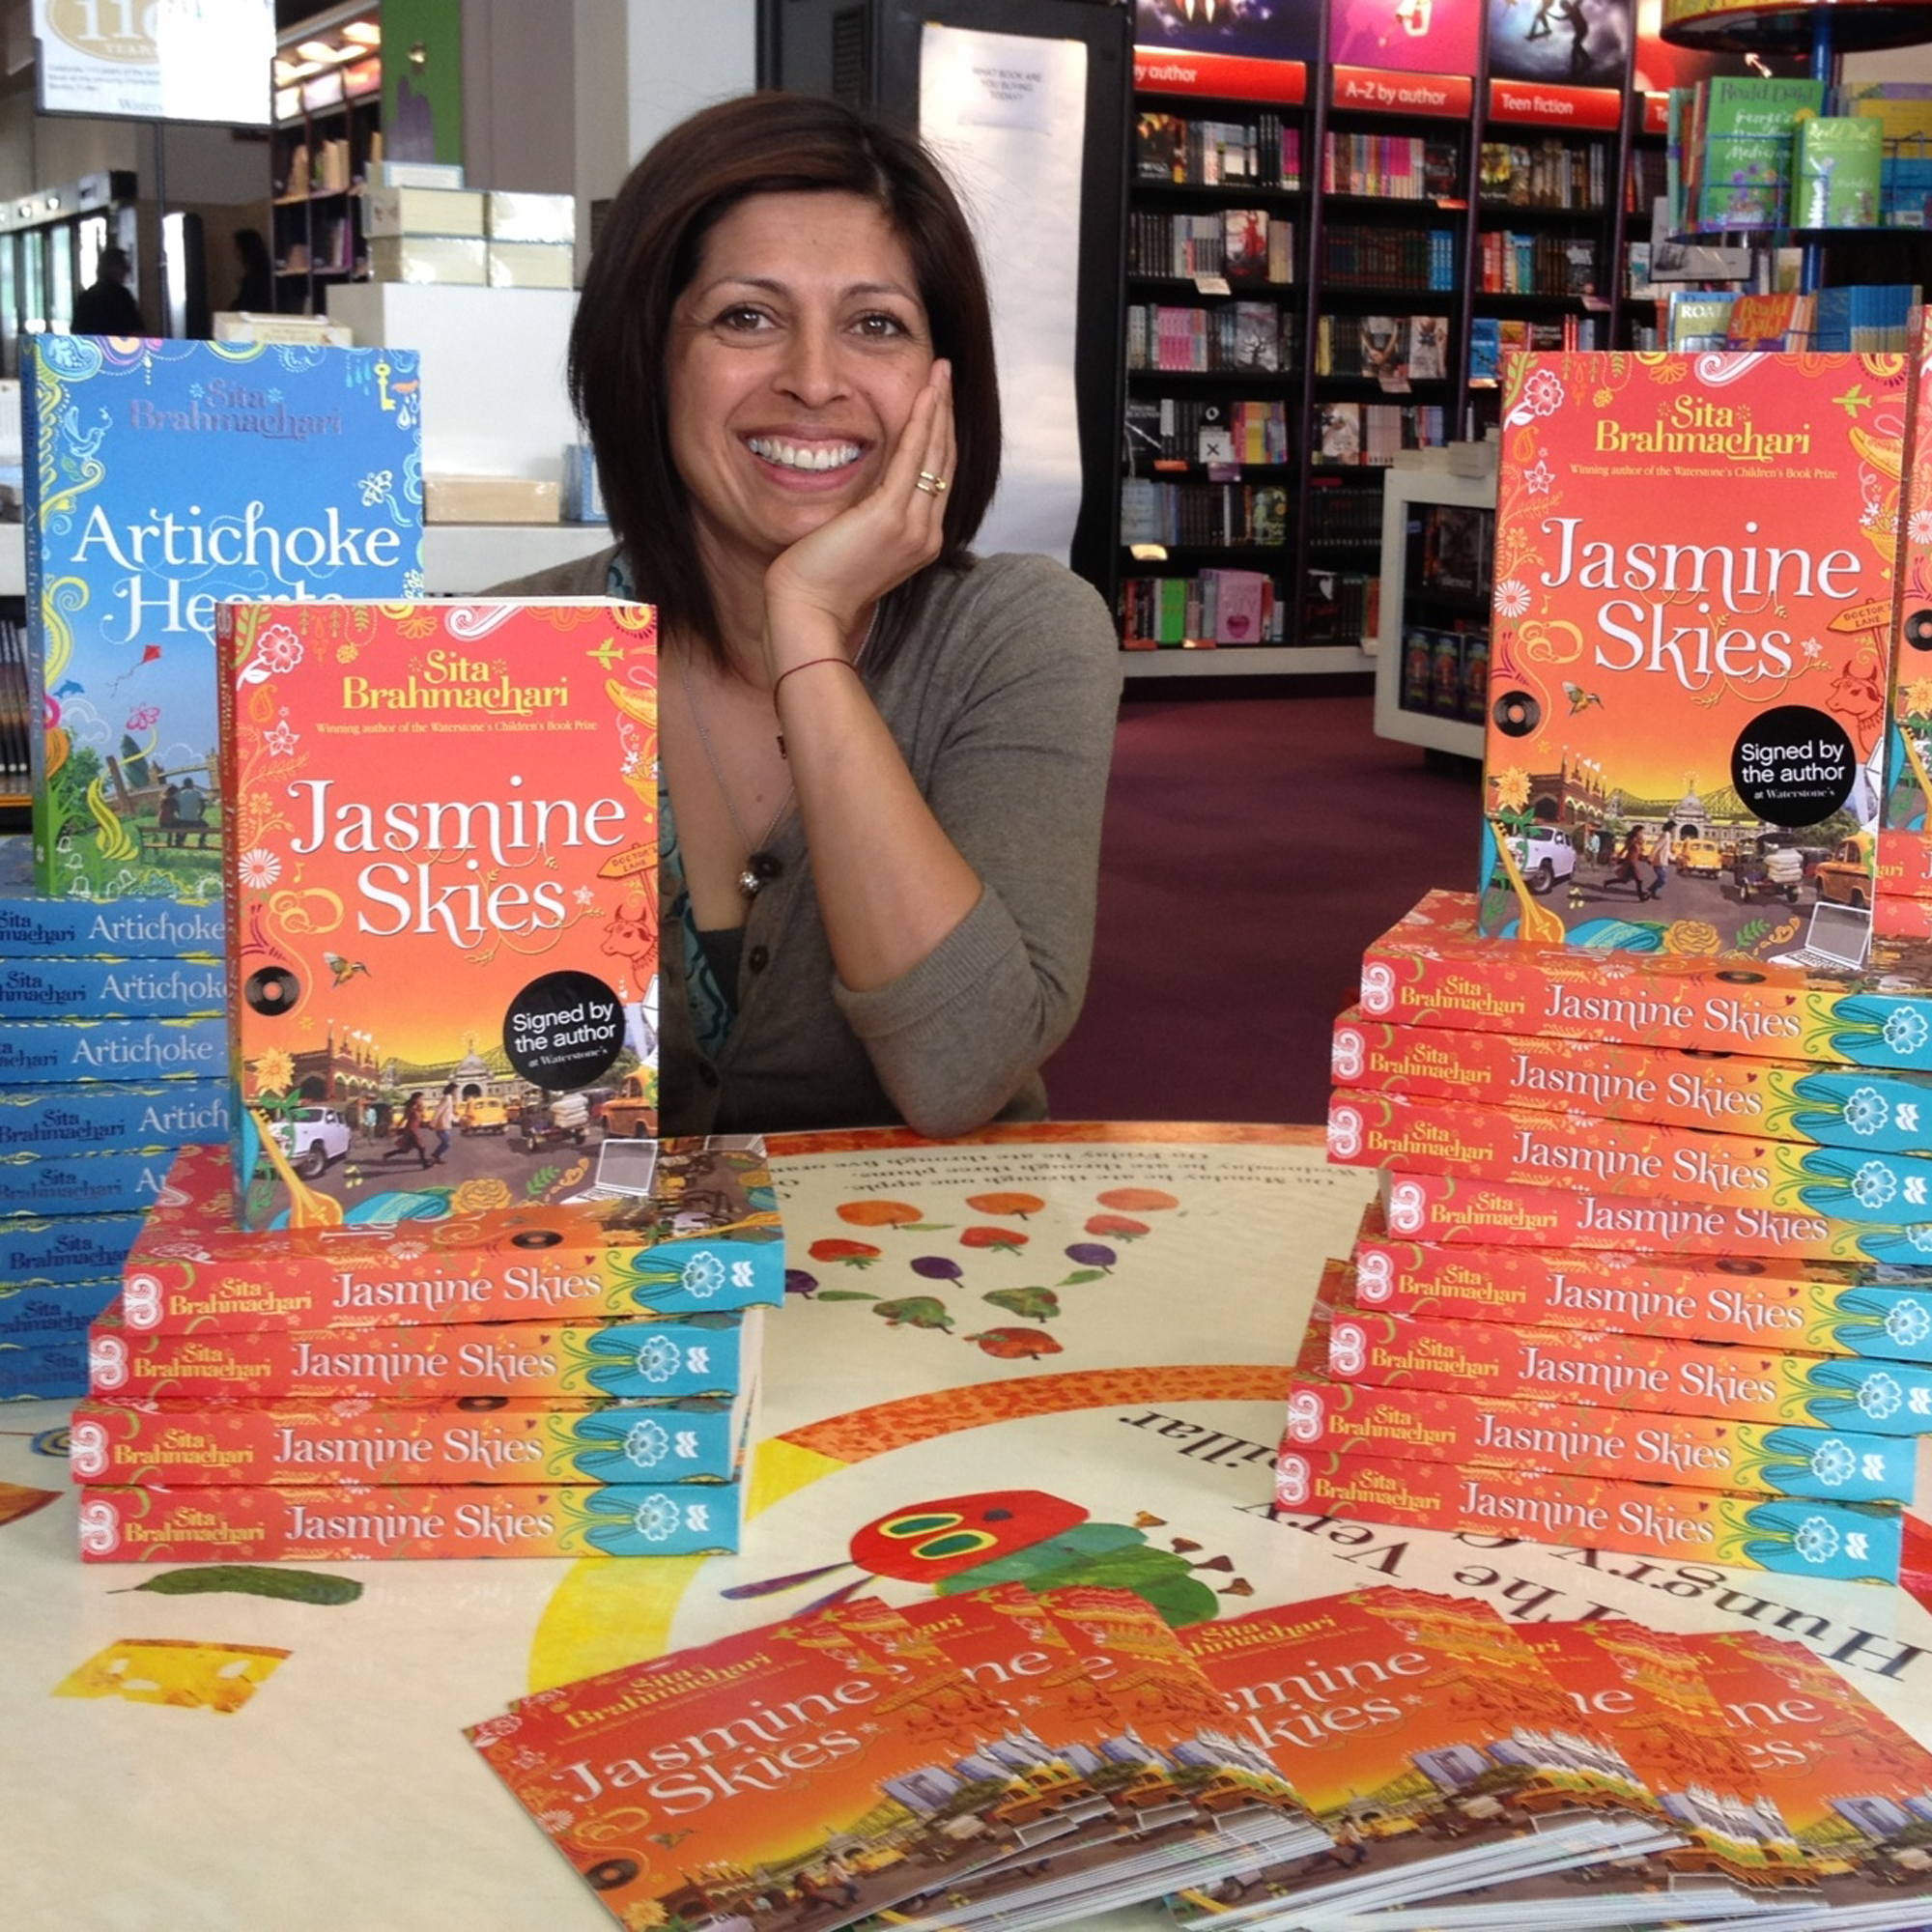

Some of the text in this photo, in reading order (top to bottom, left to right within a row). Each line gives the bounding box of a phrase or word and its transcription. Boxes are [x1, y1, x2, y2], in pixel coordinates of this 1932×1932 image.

[1134, 66, 1196, 83] y author
[1378, 85, 1396, 105] by
[1399, 88, 1446, 105] author
[1501, 94, 1575, 114] Teen fiction
[1742, 297, 1787, 318] Roald
[1740, 317, 1783, 339] Dahl
[205, 378, 266, 411] Sita
[129, 399, 343, 442] Brahmachari
[1671, 395, 1734, 429] Sita
[1596, 419, 1810, 462] Brahmachari
[1570, 464, 1838, 479] Winning author of the Waterstone's Children's Book Prize
[70, 500, 401, 584] Artichoke
[1541, 518, 1861, 612] Jasmine
[1856, 615, 1881, 627] LANE
[1596, 600, 1792, 690] Skies
[424, 649, 490, 682] Sita
[342, 676, 568, 715] Brahmachari
[316, 721, 597, 735] Winning author of the Waterstone's Children's Book Prize
[1742, 740, 1844, 764] Signed by
[1743, 763, 1845, 783] the author
[1753, 786, 1835, 800] at Waterstone's
[287, 776, 625, 867] Jasmine
[358, 859, 565, 949] Skies
[0, 923, 75, 945] machari
[88, 912, 225, 948] Artichoke
[6, 971, 43, 989] Sita
[1444, 975, 1482, 995] Sita
[0, 984, 86, 1005] hmachari
[1401, 986, 1525, 1015] Brahmachari
[512, 1002, 614, 1034] Signed by
[1546, 983, 1801, 1039] Jasmine Skies
[71, 1034, 213, 1069] Artichoke
[515, 1024, 616, 1053] the author
[540, 1046, 608, 1065] Waterstone's
[1412, 1043, 1448, 1065] Sita
[1370, 1054, 1492, 1086] Brahmachari
[1511, 1054, 1762, 1115] Jasmine Skies
[42, 1108, 80, 1127] Sita
[138, 1098, 230, 1136] Artich
[0, 1120, 125, 1142] Brahmachari
[1413, 1121, 1449, 1142] Sita
[1368, 1132, 1493, 1162] Brahmachari
[1514, 1130, 1770, 1189] Jasmine Skies
[40, 1168, 77, 1186] Sita
[1476, 1192, 1513, 1211] Sita
[1432, 1204, 1557, 1230] Brahmachari
[1577, 1196, 1828, 1242] Jasmine Skies
[55, 1235, 93, 1253] Sita
[218, 1278, 263, 1297] Sita
[333, 1265, 602, 1310] Jasmine Skies
[1444, 1264, 1482, 1284] Sita
[169, 1291, 312, 1316] Brahmachari
[1400, 1277, 1526, 1305] Brahmachari
[1546, 1272, 1804, 1330] Jasmine Skies
[181, 1343, 223, 1365] Sita
[1416, 1337, 1455, 1358] Sita
[133, 1358, 271, 1381] Brahmachari
[291, 1343, 557, 1390] Jasmine Skies
[1372, 1349, 1499, 1379] Brahmachari
[1519, 1345, 1776, 1404] Jasmine Skies
[1373, 1405, 1411, 1426] Sita
[163, 1429, 205, 1450] Sita
[1328, 1415, 1457, 1446] Brahmachari
[1474, 1413, 1731, 1471] Jasmine Skies
[114, 1443, 253, 1467] Brahmachari
[273, 1429, 543, 1476] Jasmine Skies
[1358, 1469, 1398, 1490] Sita
[1315, 1479, 1440, 1511] Brahmachari
[174, 1508, 216, 1527] Sita
[1460, 1481, 1715, 1544] Jasmine Skies
[125, 1521, 264, 1546] Brahmachari
[284, 1505, 554, 1553] Jasmine Skies
[1200, 1619, 1261, 1641] Sita
[630, 1668, 693, 1691] Sita
[1246, 1697, 1402, 1749] kies
[552, 1681, 879, 1804] Jasmine
[648, 1730, 861, 1816] Skies
